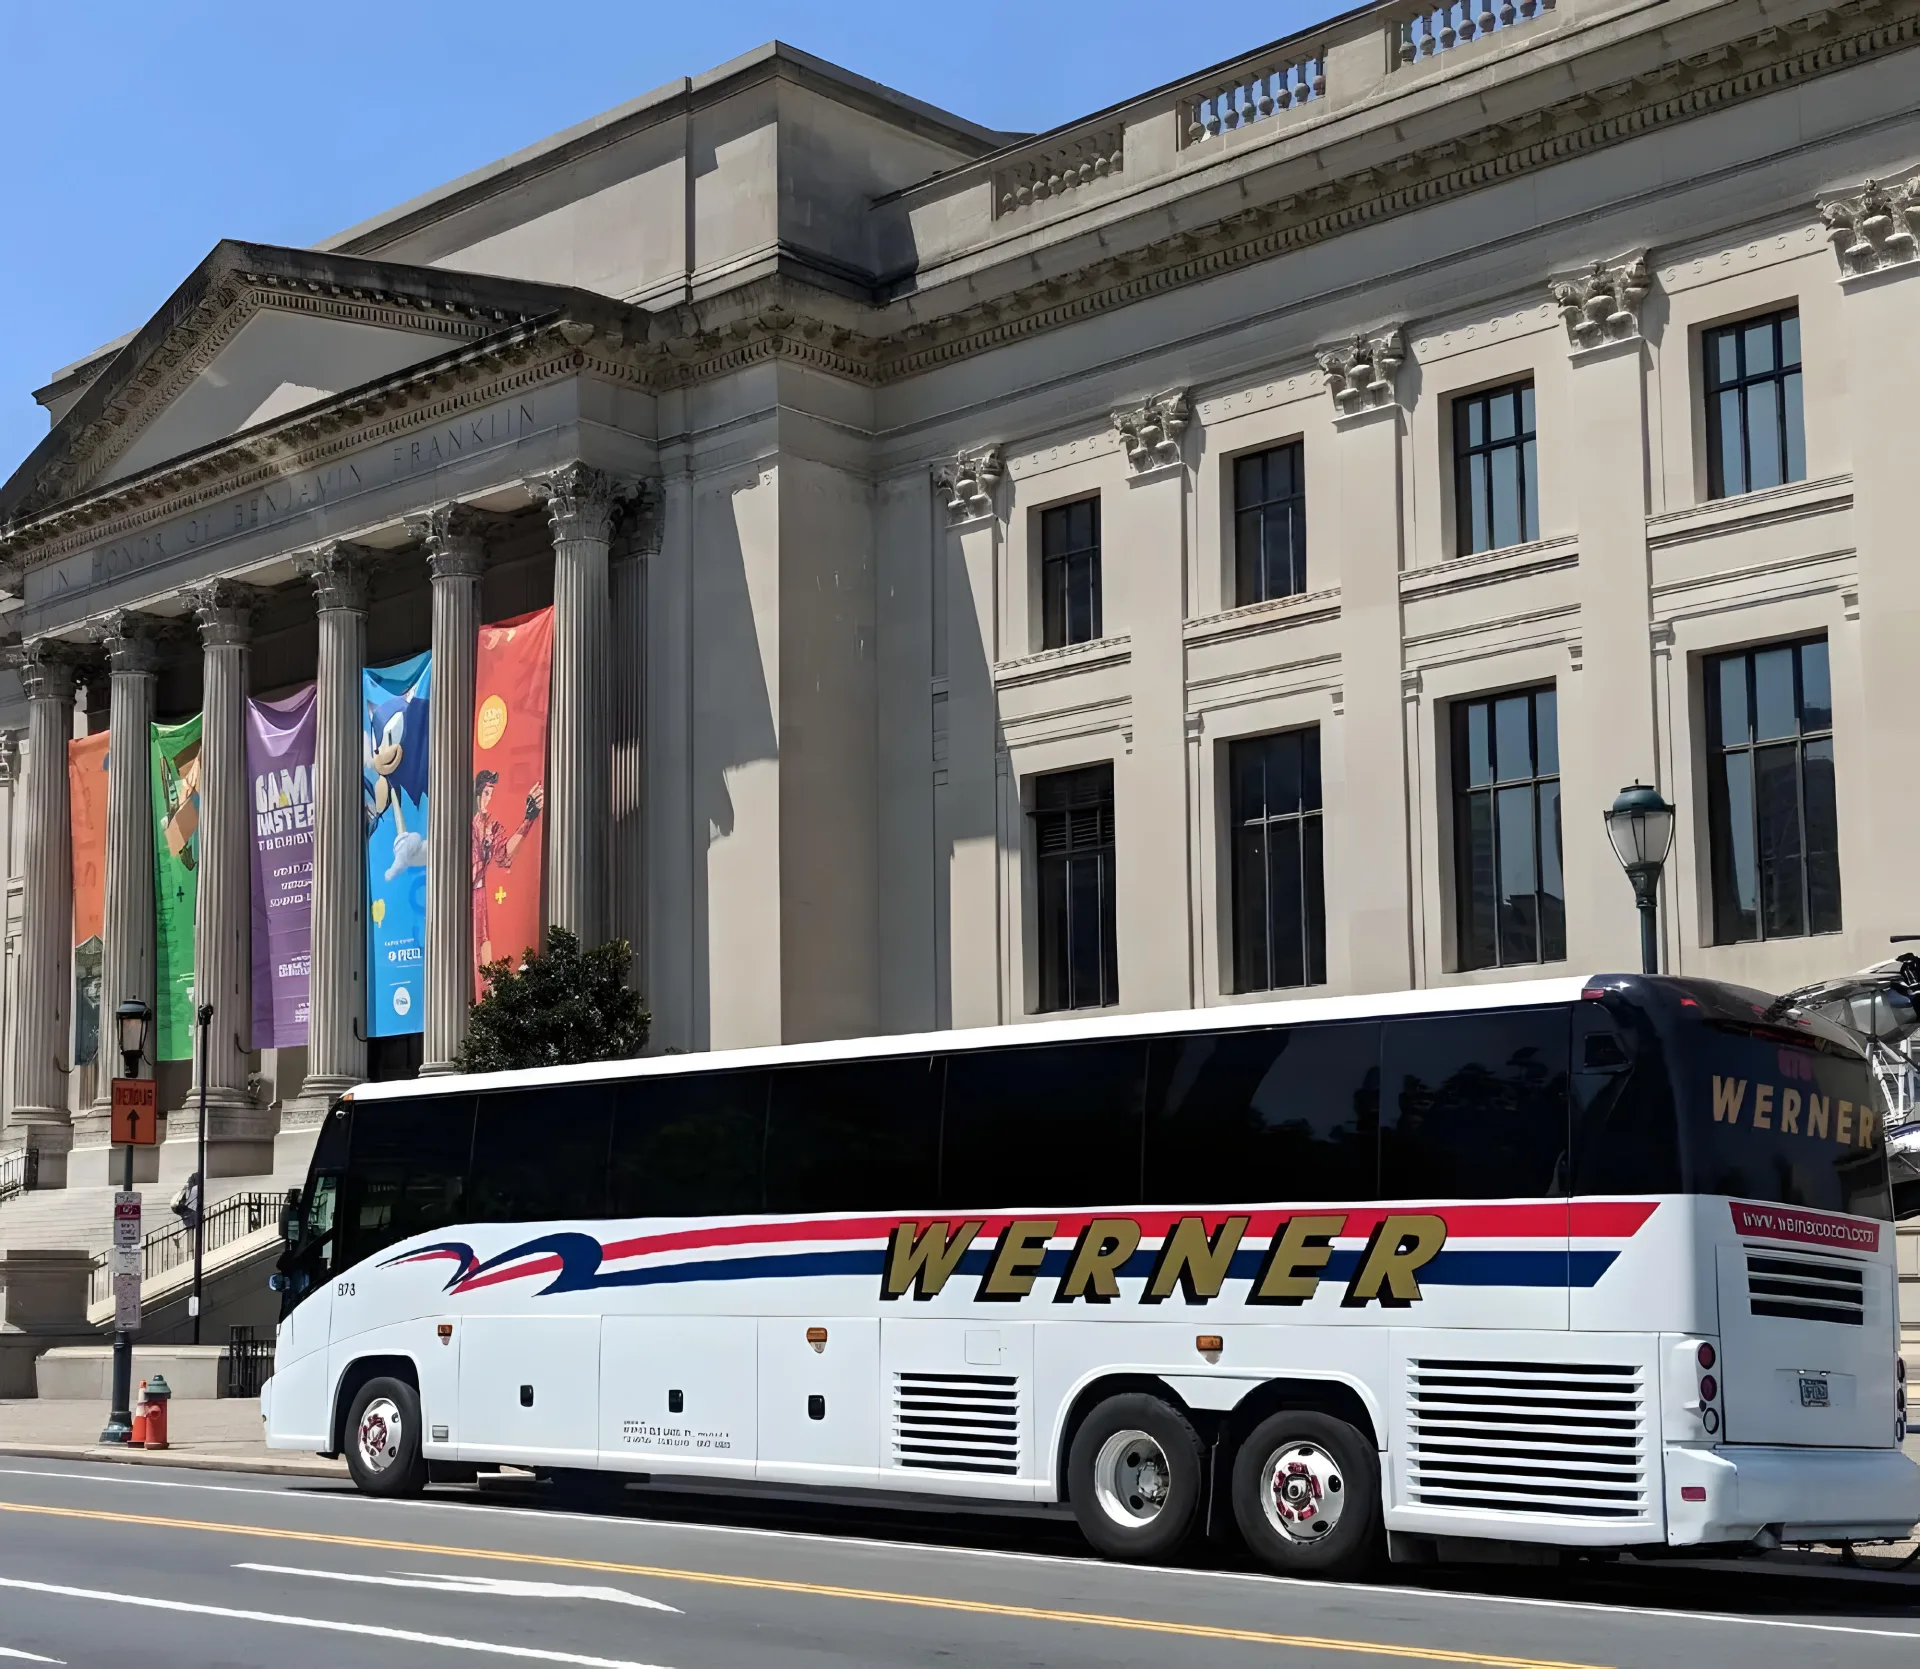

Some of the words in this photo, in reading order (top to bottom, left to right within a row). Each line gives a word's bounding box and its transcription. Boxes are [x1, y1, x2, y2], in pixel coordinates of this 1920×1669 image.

[393, 399, 535, 473] FRANKLIN
[1713, 1074, 1874, 1149] WERNER
[337, 1282, 356, 1297] 873
[879, 1214, 1448, 1308] WERNER
